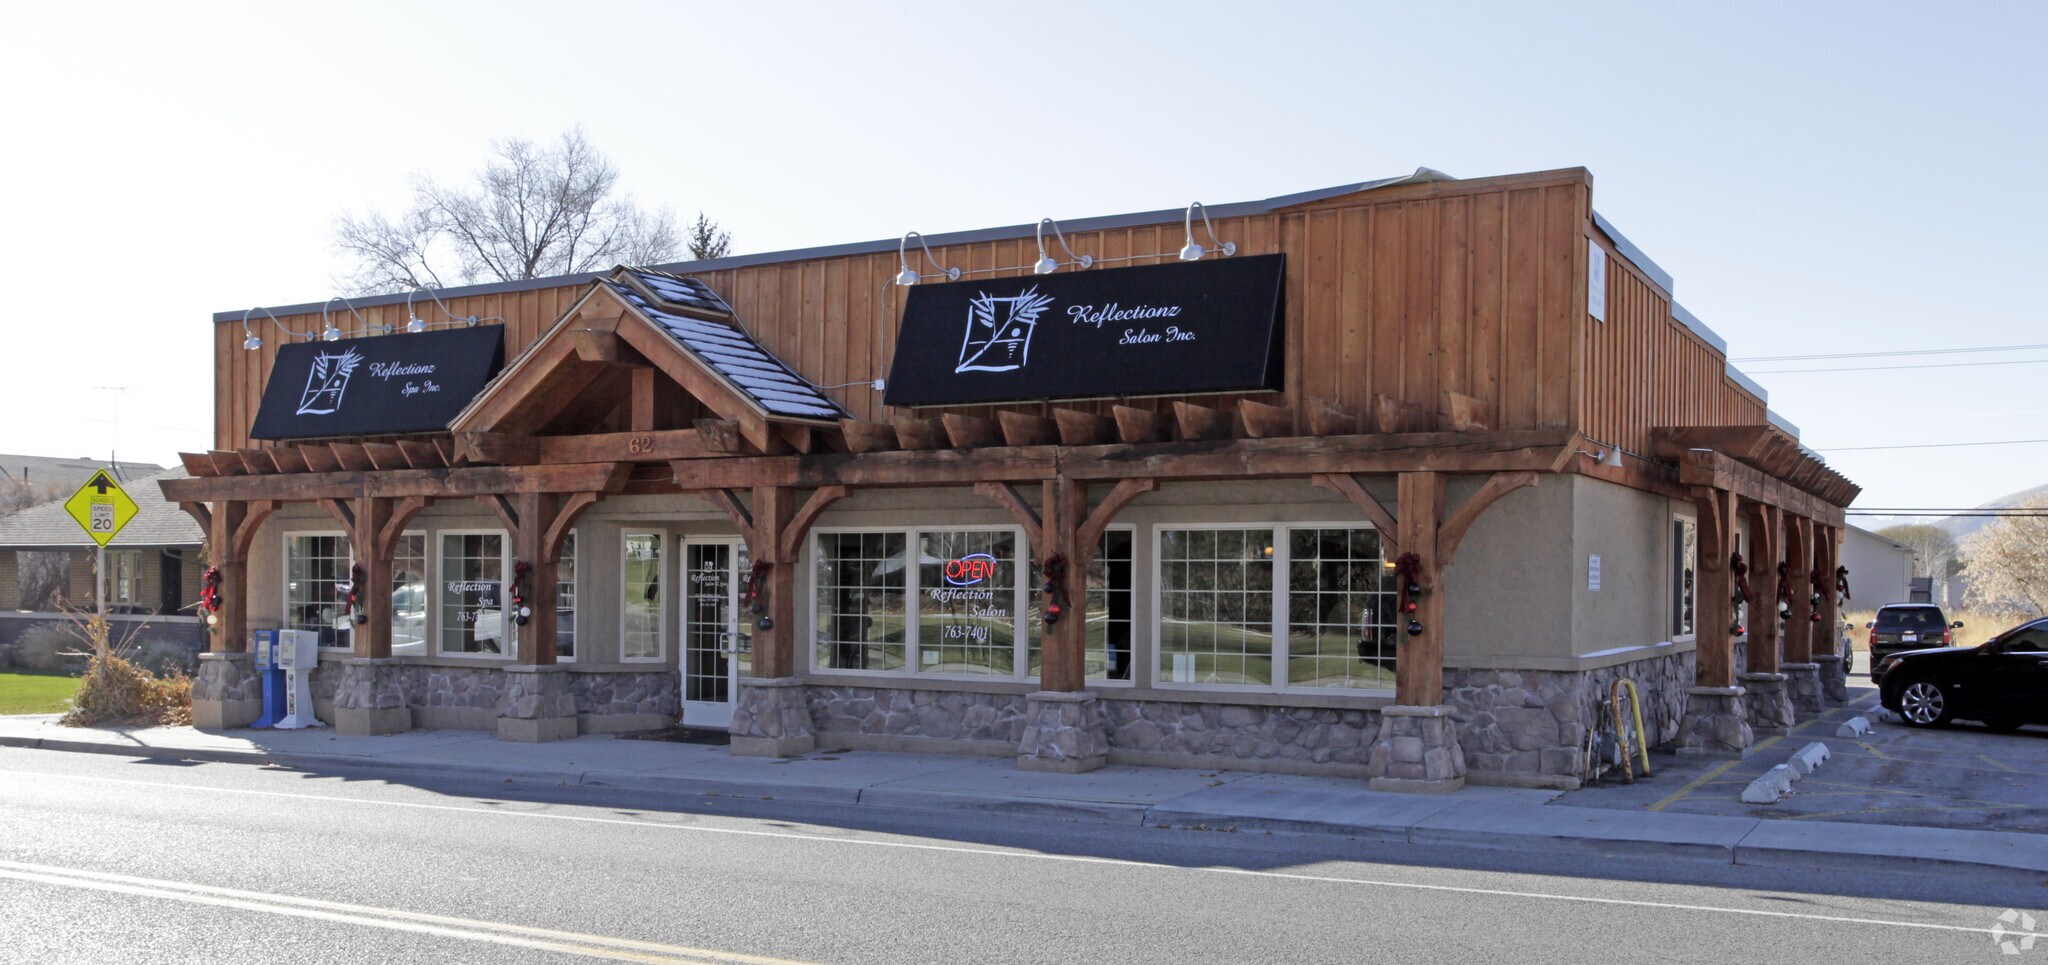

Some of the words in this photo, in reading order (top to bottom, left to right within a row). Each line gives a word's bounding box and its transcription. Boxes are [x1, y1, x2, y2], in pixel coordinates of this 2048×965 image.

[1067, 302, 1182, 328] Reflectionz
[1119, 328, 1161, 345] Salon
[1166, 325, 1196, 342] Inc.
[369, 361, 436, 381] Reflectionz
[402, 381, 420, 398] Spa
[629, 436, 653, 454] 62
[93, 518, 112, 530] 20
[946, 560, 995, 579] OPEN
[691, 574, 720, 583] Reflection
[447, 582, 491, 595] Reflection
[930, 588, 994, 603] Reflection
[477, 597, 494, 609] Spa
[970, 605, 1006, 617] Salon
[944, 625, 988, 639] 763-7401
